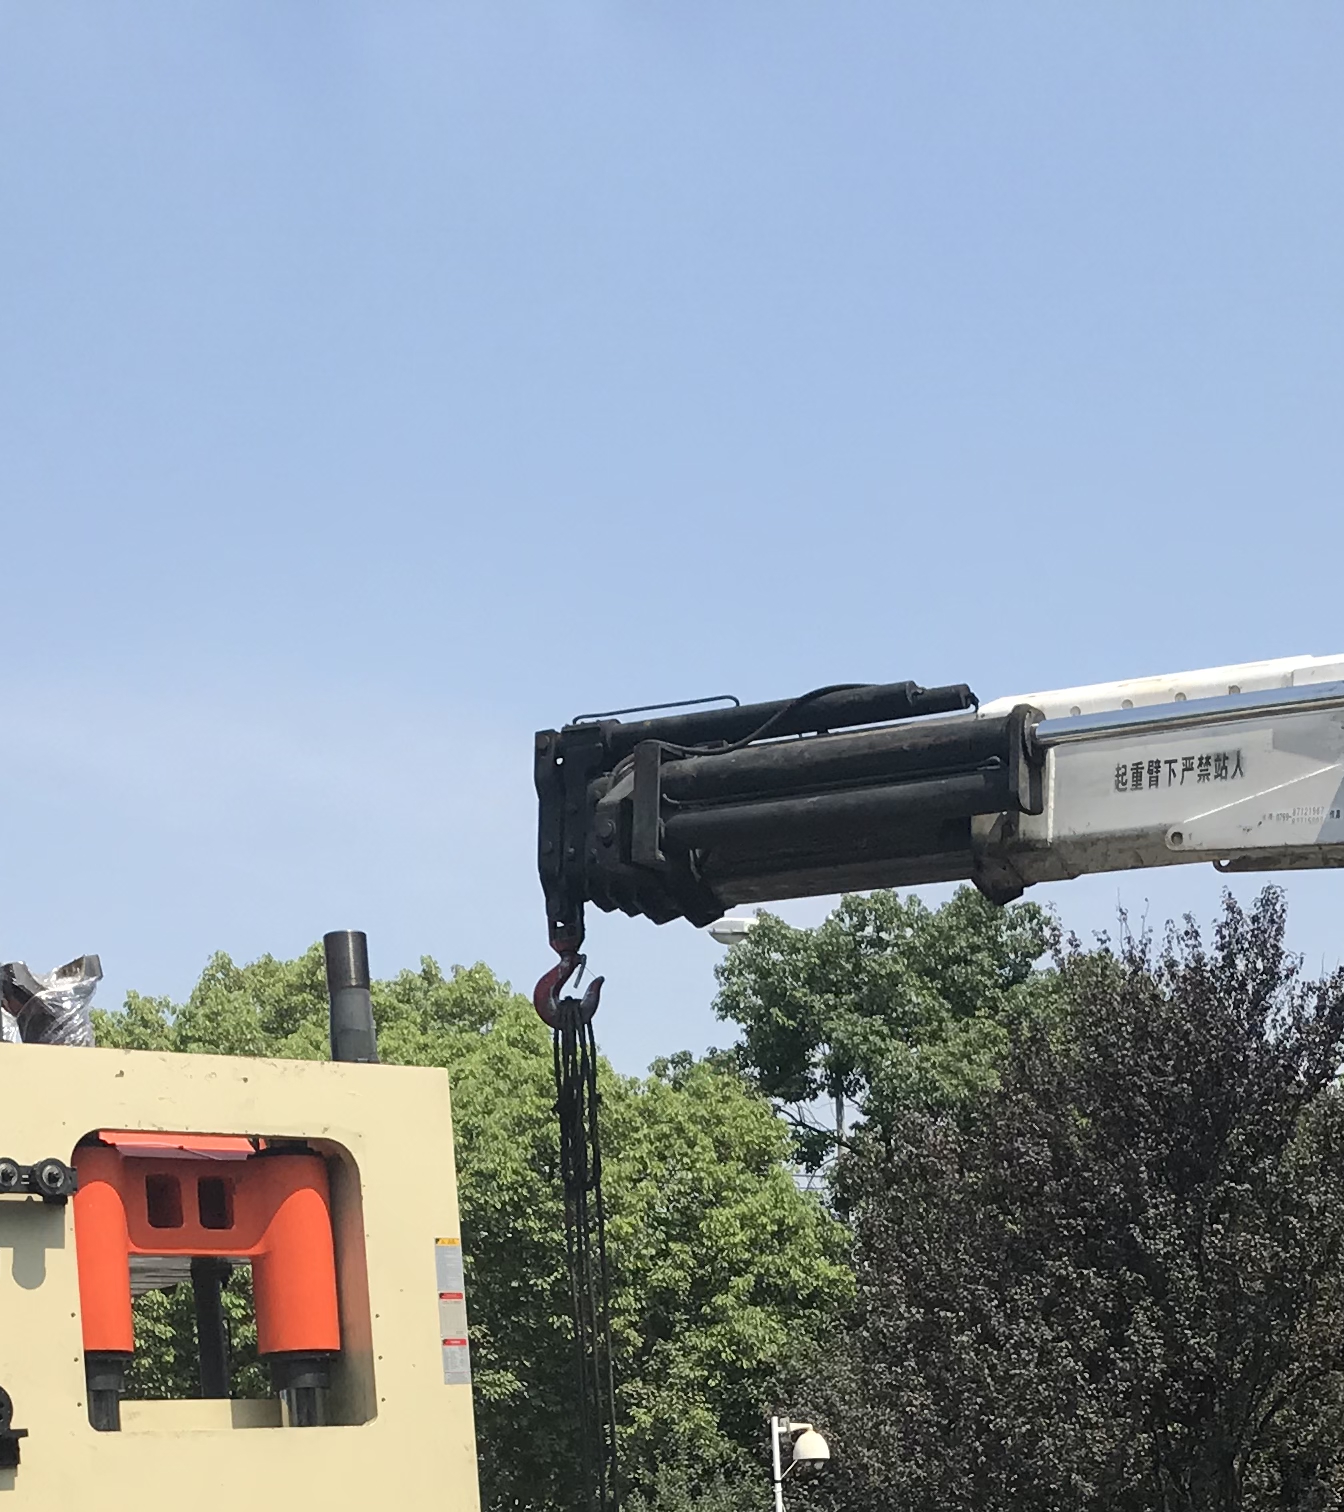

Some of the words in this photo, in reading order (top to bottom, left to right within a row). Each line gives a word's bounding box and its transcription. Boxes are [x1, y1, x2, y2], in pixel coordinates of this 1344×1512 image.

[1114, 749, 1245, 793] 起重臂下严禁站人
